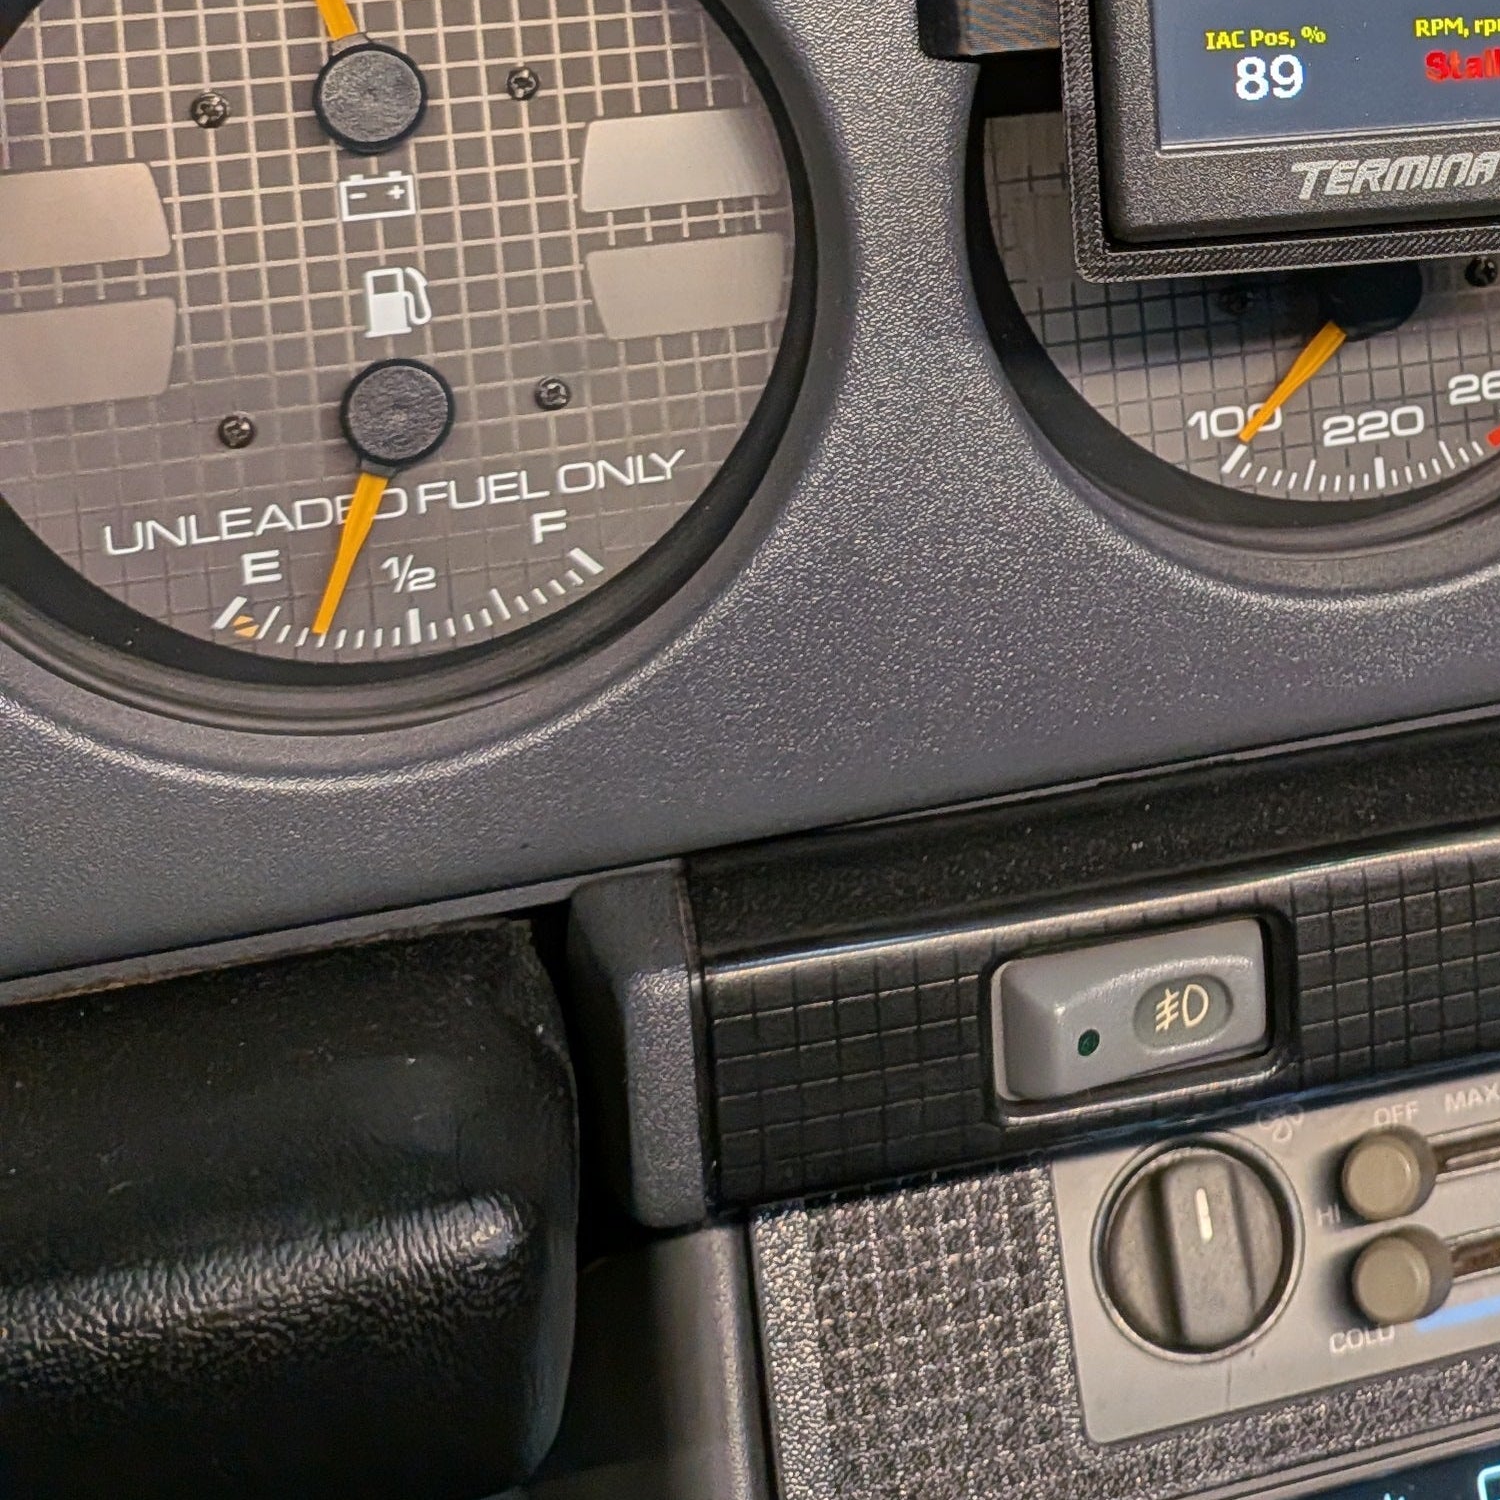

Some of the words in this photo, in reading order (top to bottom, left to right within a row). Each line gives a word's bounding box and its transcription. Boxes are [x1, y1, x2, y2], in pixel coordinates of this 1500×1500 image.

[1205, 30, 1246, 50] IAC
[1250, 29, 1296, 49] Pos,
[1301, 26, 1327, 44] %
[1415, 17, 1470, 38] RPM,
[1235, 54, 1304, 101] 89
[1187, 402, 1283, 441] 100
[1322, 404, 1425, 447] 220
[416, 470, 550, 516] FUEL
[556, 448, 687, 496] ONLY
[531, 507, 569, 545] F
[242, 549, 284, 585] E
[1373, 1101, 1419, 1128] OFF
[1445, 1082, 1500, 1113] MAX
